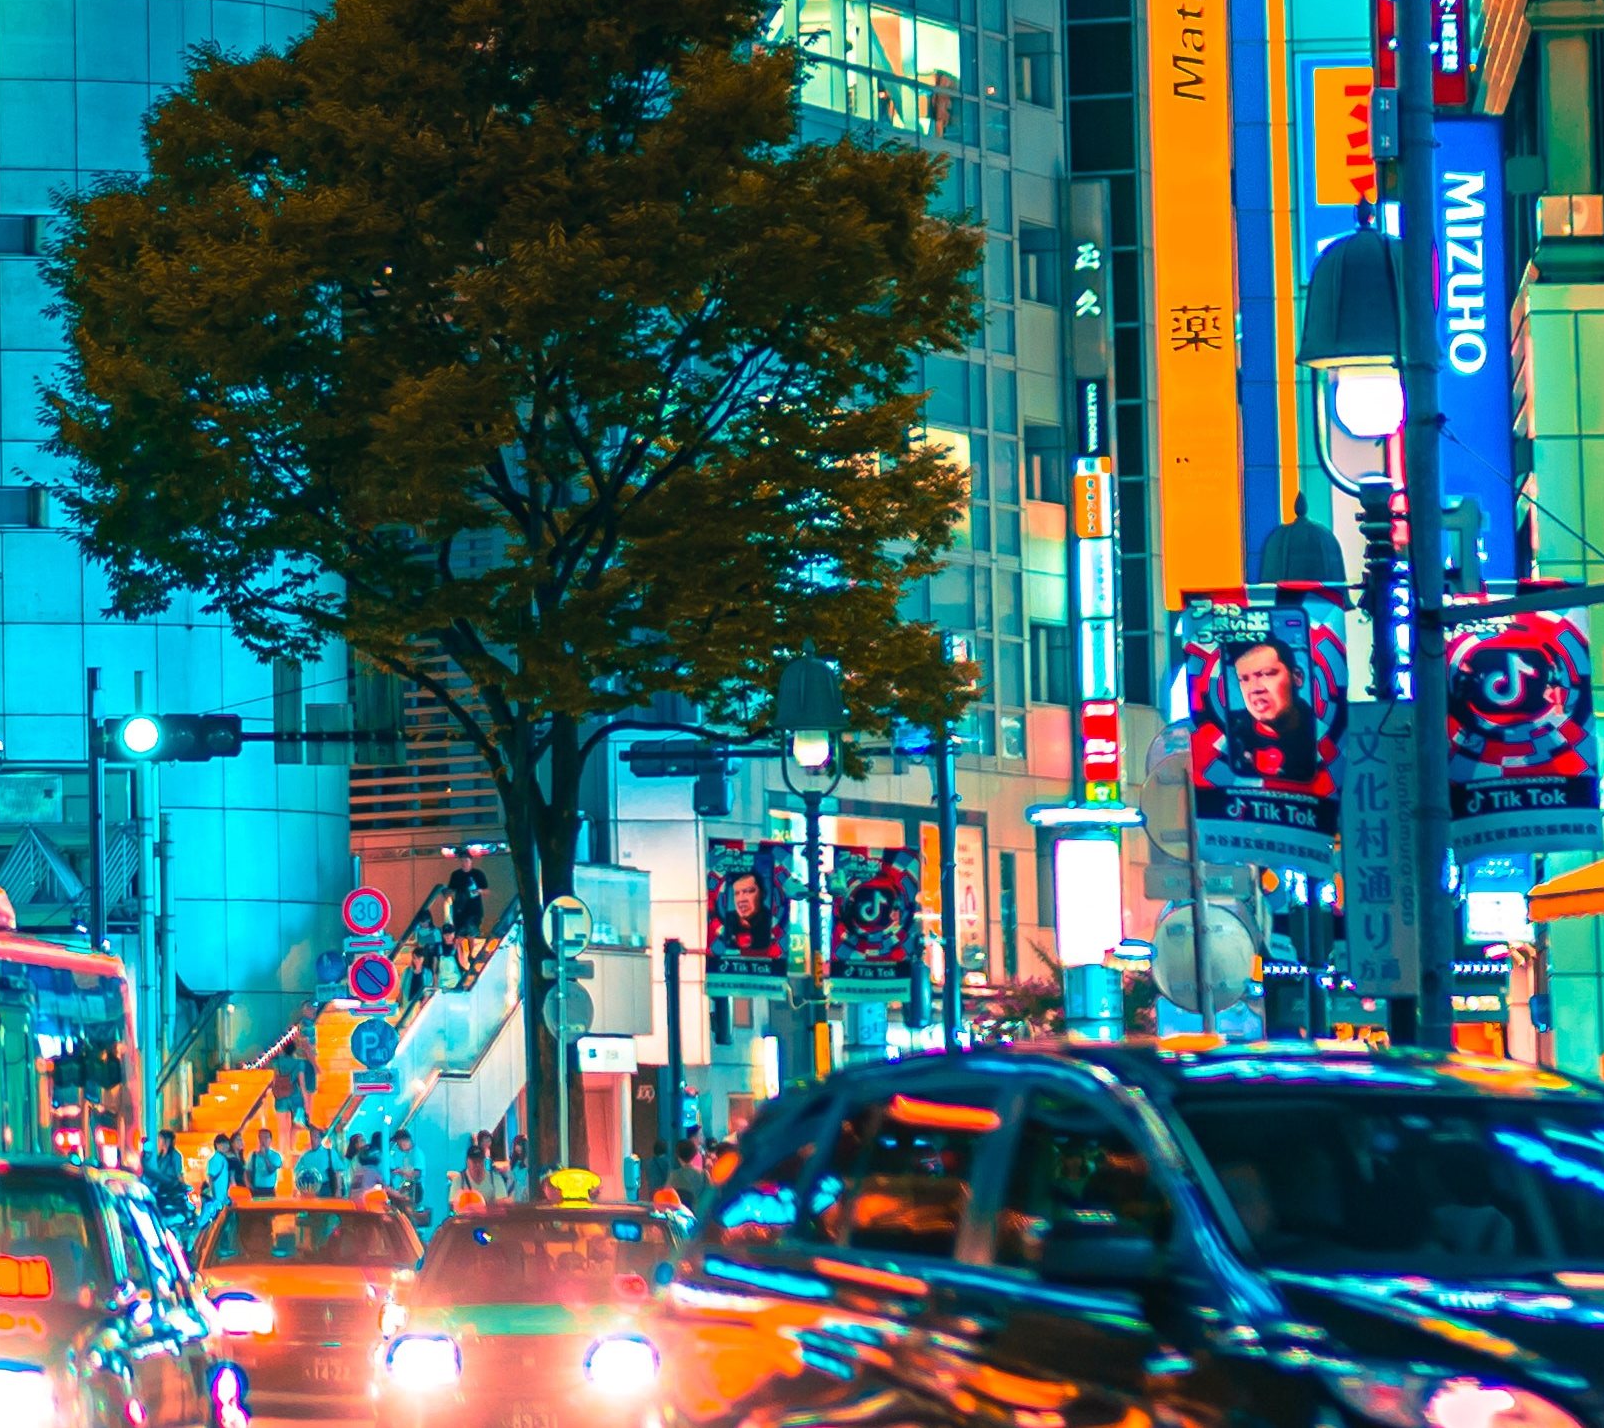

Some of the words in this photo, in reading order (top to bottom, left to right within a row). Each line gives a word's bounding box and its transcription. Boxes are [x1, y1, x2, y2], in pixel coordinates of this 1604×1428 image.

[1442, 169, 1489, 376] MIZUHO
[1170, 303, 1224, 353] 薬
[1250, 801, 1282, 821] Tik
[1284, 803, 1317, 827] Tok
[1488, 788, 1522, 808] Tik
[1530, 787, 1567, 807] Tok
[1348, 725, 1393, 953] 文化村通り
[353, 899, 382, 922] 30
